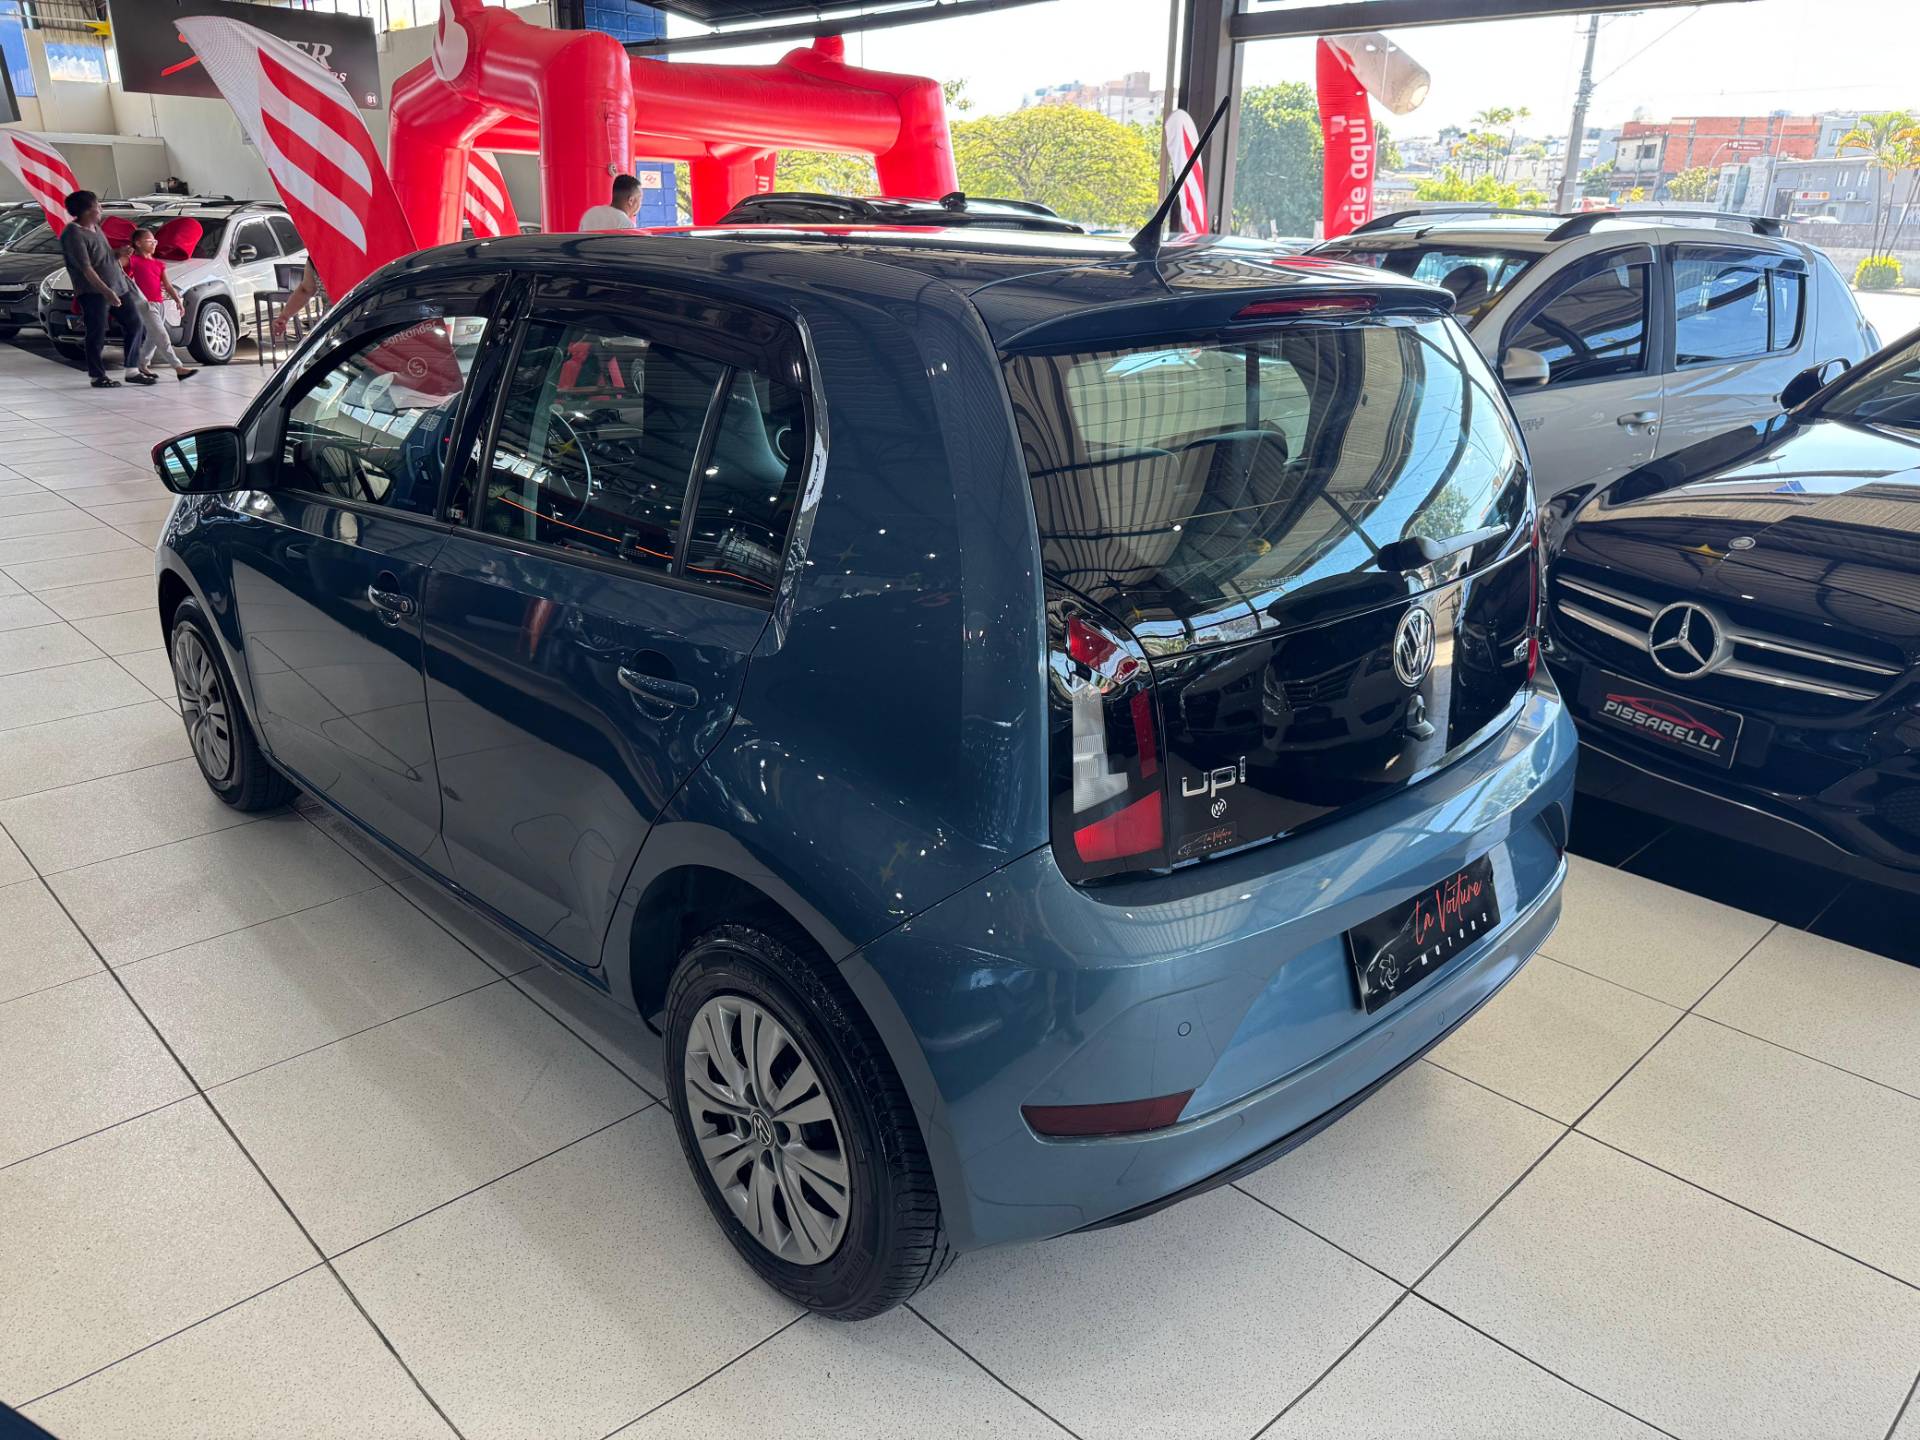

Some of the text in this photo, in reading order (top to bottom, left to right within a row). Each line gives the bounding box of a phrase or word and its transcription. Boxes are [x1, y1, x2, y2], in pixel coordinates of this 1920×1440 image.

[1348, 118, 1372, 180] aqui
[755, 174, 770, 193] ui
[382, 319, 438, 349] Santander
[1603, 700, 1721, 751] PISSARELLI
[1181, 755, 1246, 798] up!
[1414, 872, 1483, 945] La Voiture
[1420, 912, 1488, 966] MOTORS
